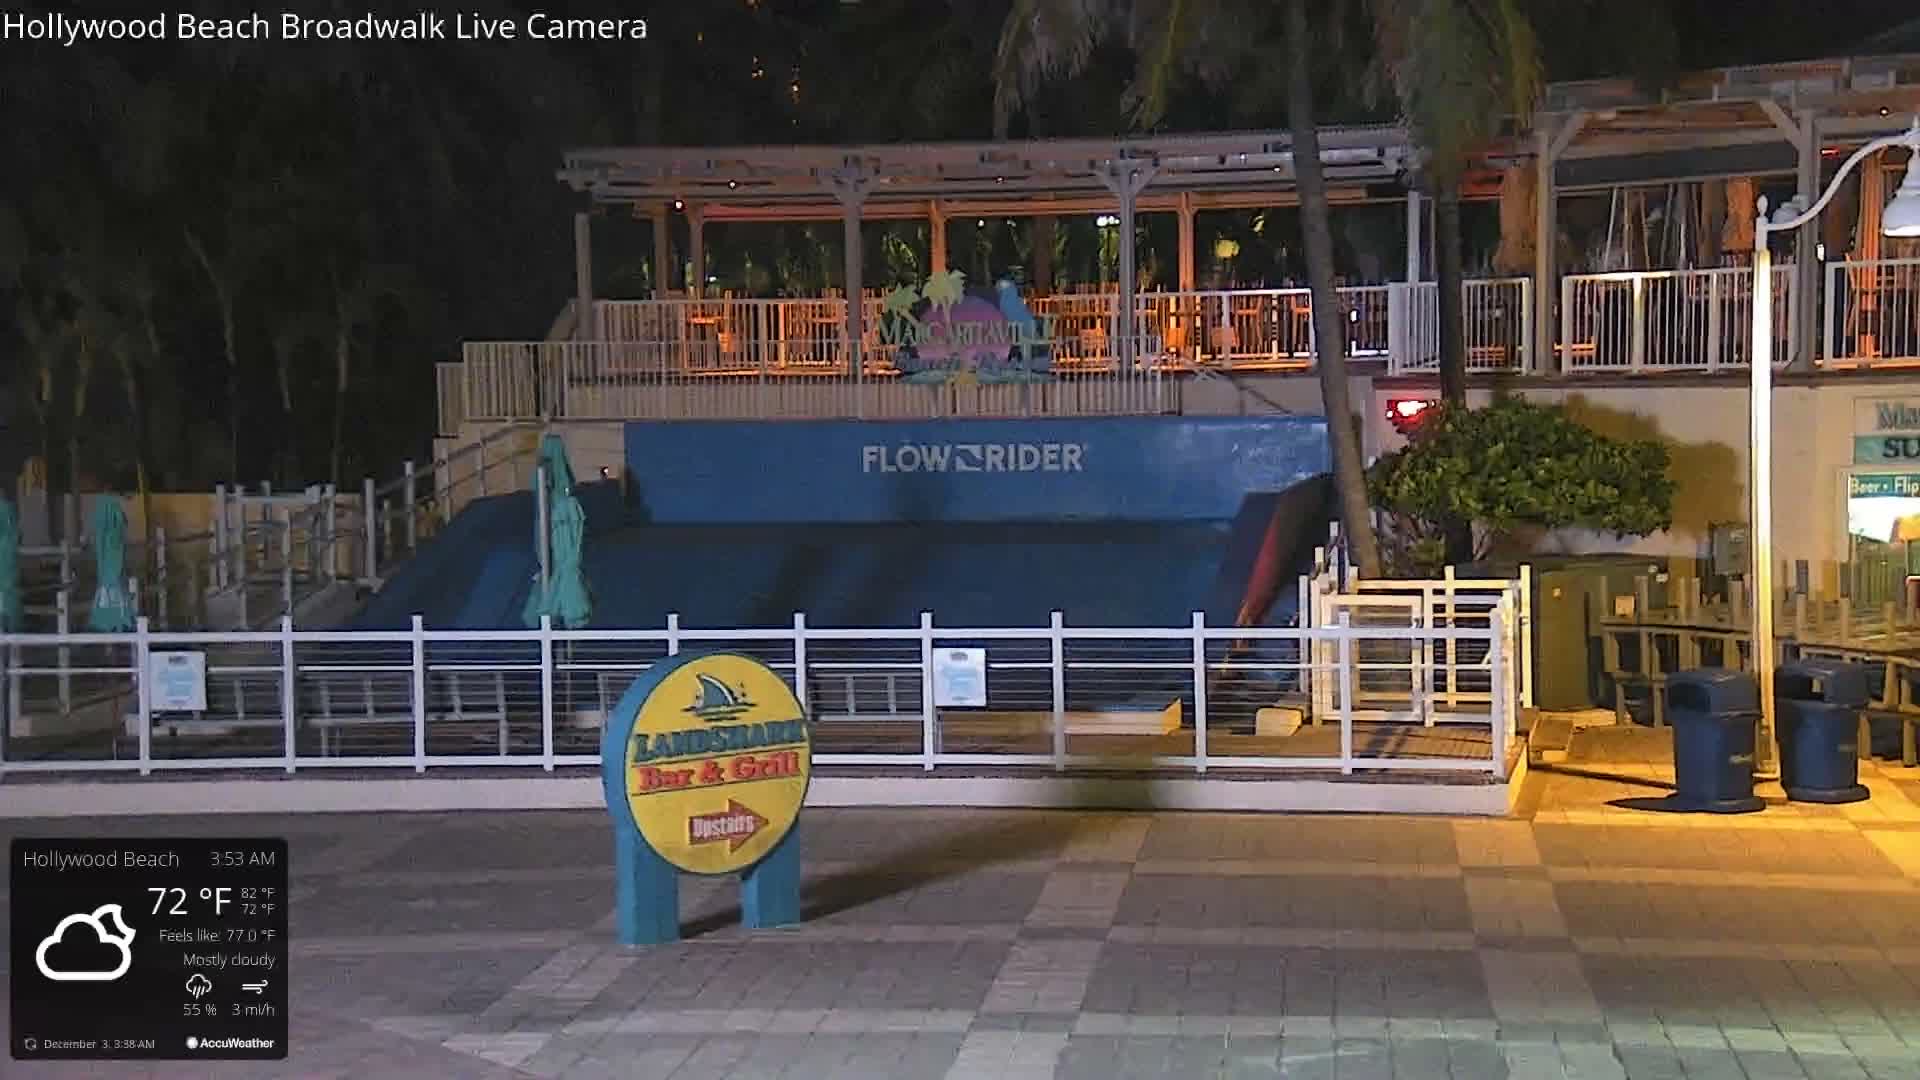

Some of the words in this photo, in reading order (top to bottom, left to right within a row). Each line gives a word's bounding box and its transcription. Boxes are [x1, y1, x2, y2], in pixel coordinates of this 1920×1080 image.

[862, 446, 951, 472] FLOW
[985, 443, 1084, 471] RIDER
[1850, 478, 1881, 494] Beer
[634, 718, 808, 763] LANDSHARK
[639, 765, 695, 791] Bar
[699, 759, 725, 783] &
[731, 750, 800, 779] Grill
[691, 814, 755, 838] Upstairs
